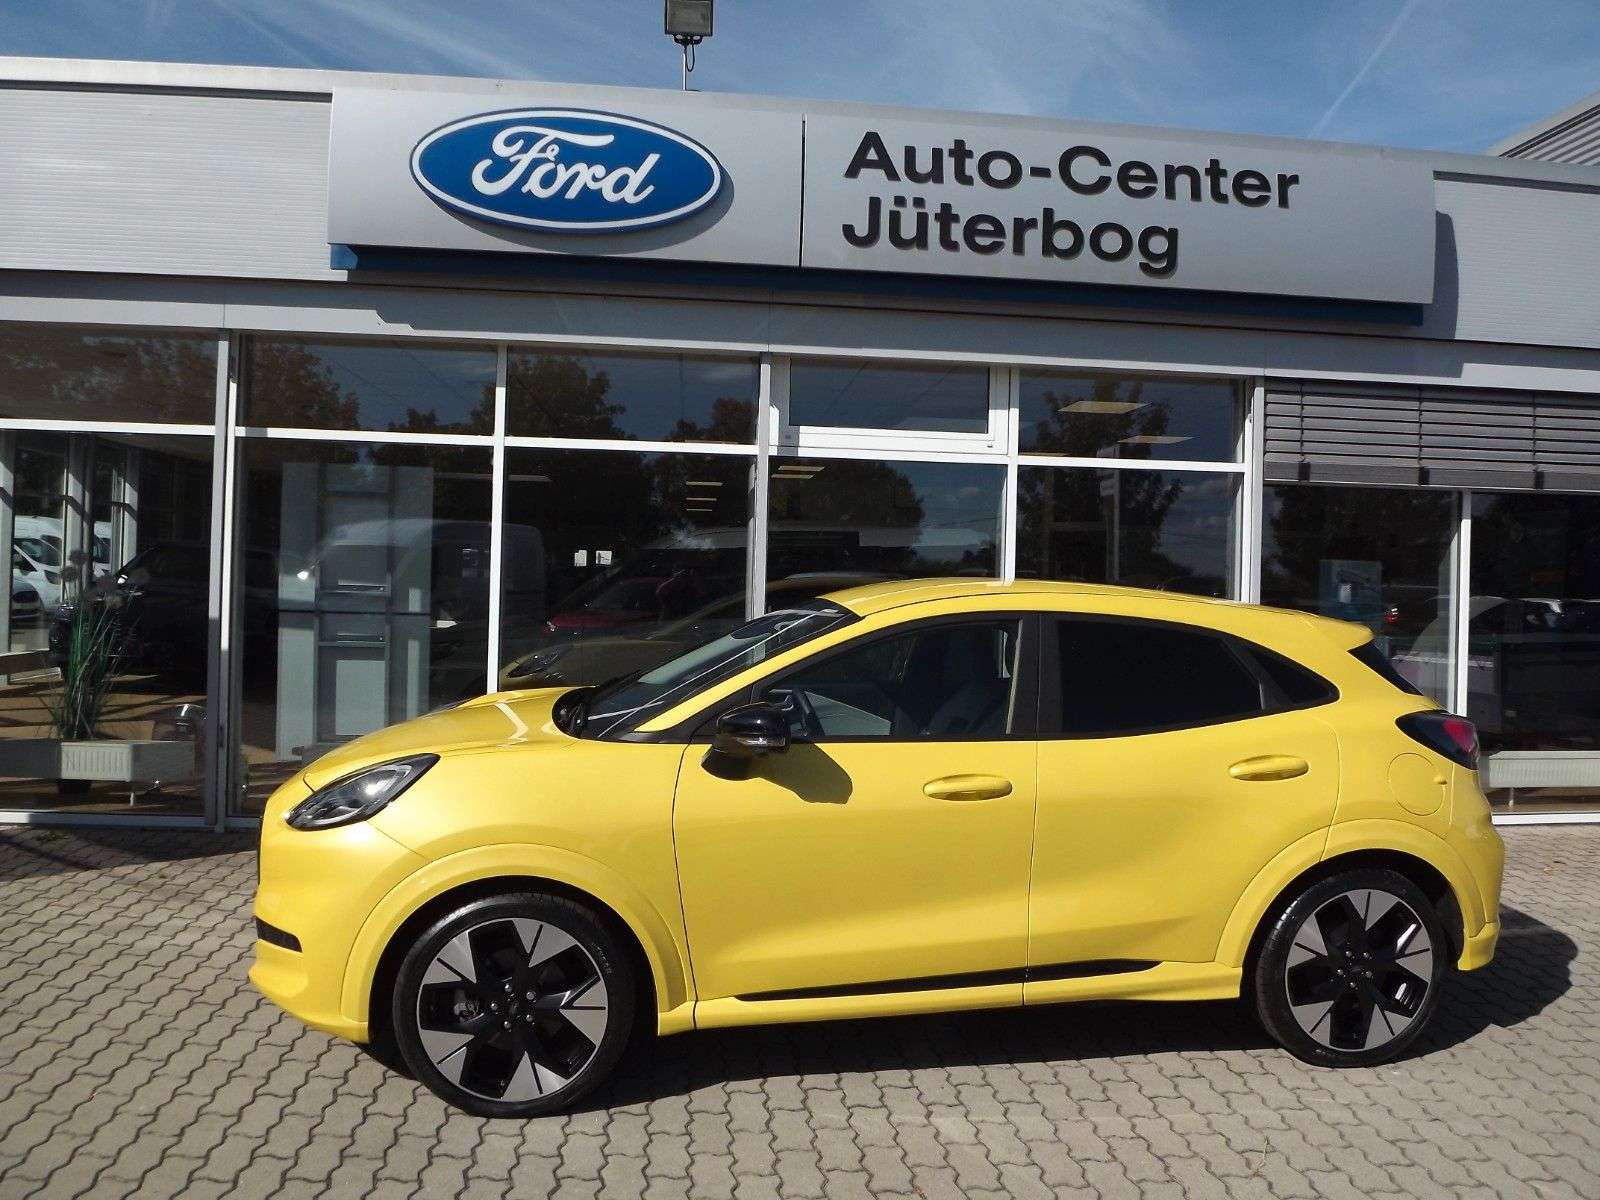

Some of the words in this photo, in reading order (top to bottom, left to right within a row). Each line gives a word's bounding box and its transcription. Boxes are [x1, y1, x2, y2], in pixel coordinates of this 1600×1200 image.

[472, 125, 661, 204] Ford
[844, 131, 1300, 208] Auto-Center
[842, 195, 1180, 278] Jüterbog
